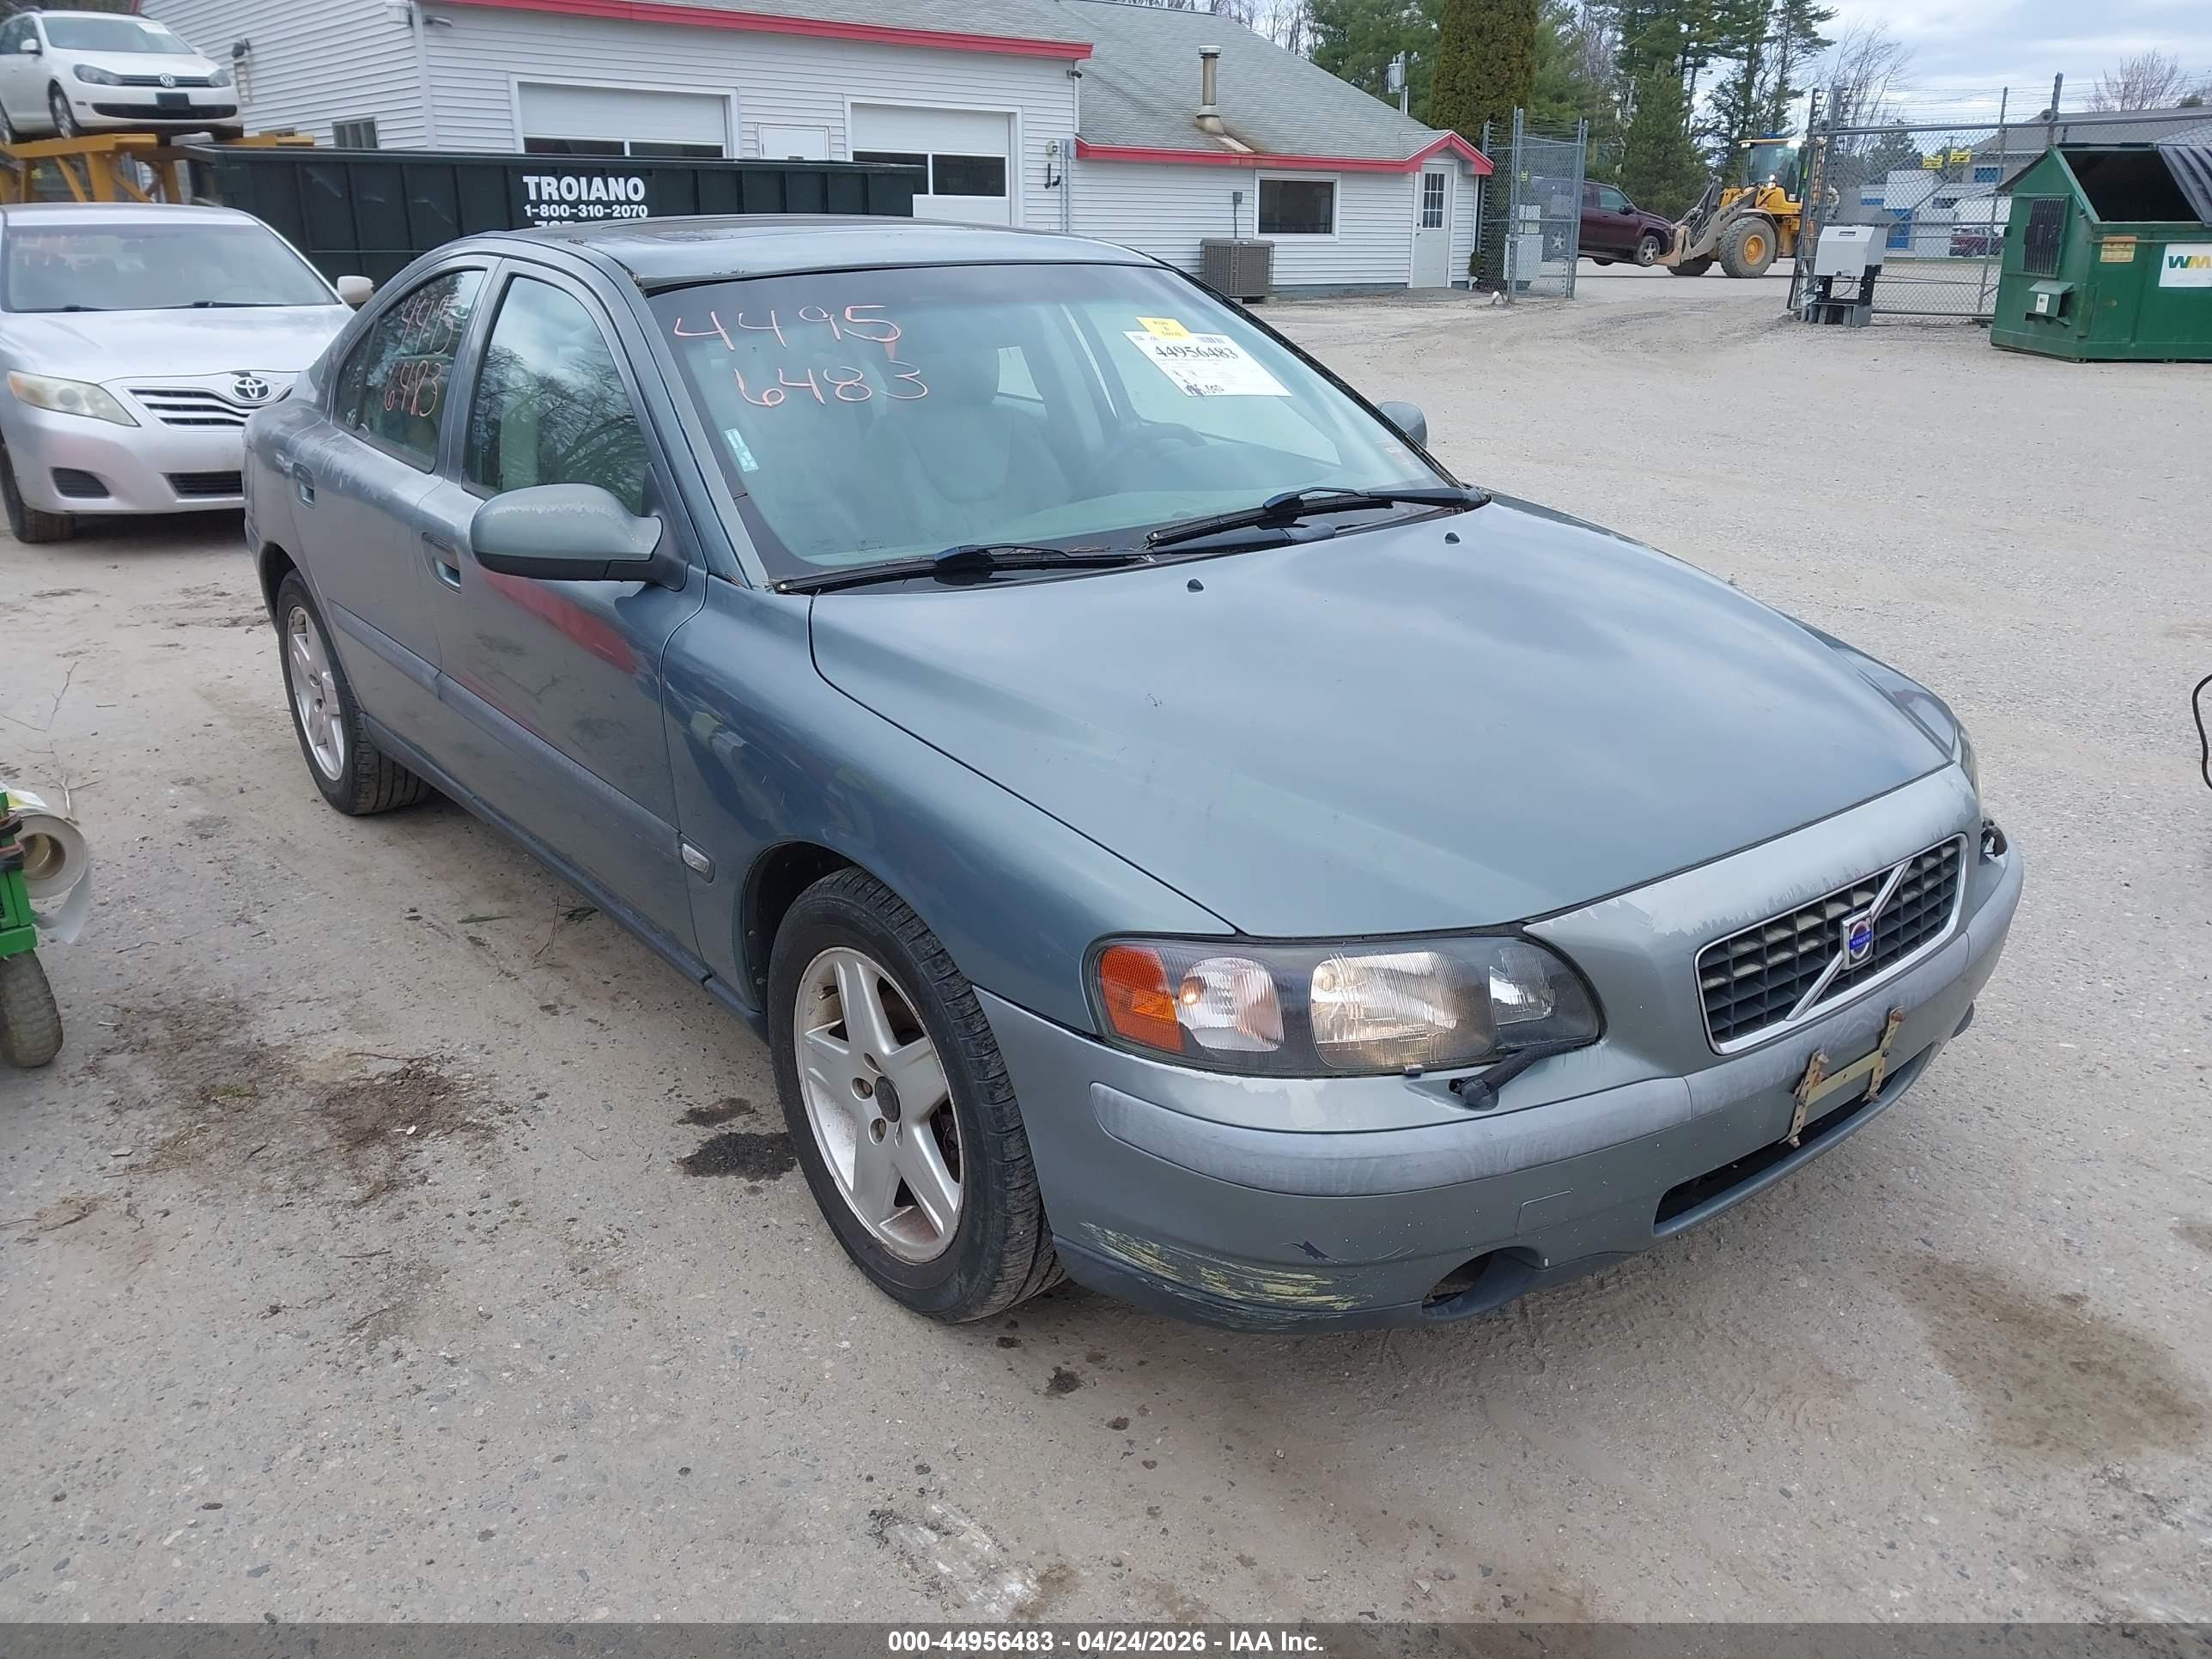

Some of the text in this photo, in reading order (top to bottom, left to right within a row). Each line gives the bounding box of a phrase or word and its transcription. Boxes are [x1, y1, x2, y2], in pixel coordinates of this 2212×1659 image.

[522, 175, 646, 202] TROIANO
[524, 204, 648, 218] 1-800-310-2070
[2167, 255, 2212, 269] WM
[673, 305, 902, 350] 4495
[1155, 346, 1239, 359] 44956483
[384, 360, 442, 417] 6483
[734, 360, 928, 407] 6483
